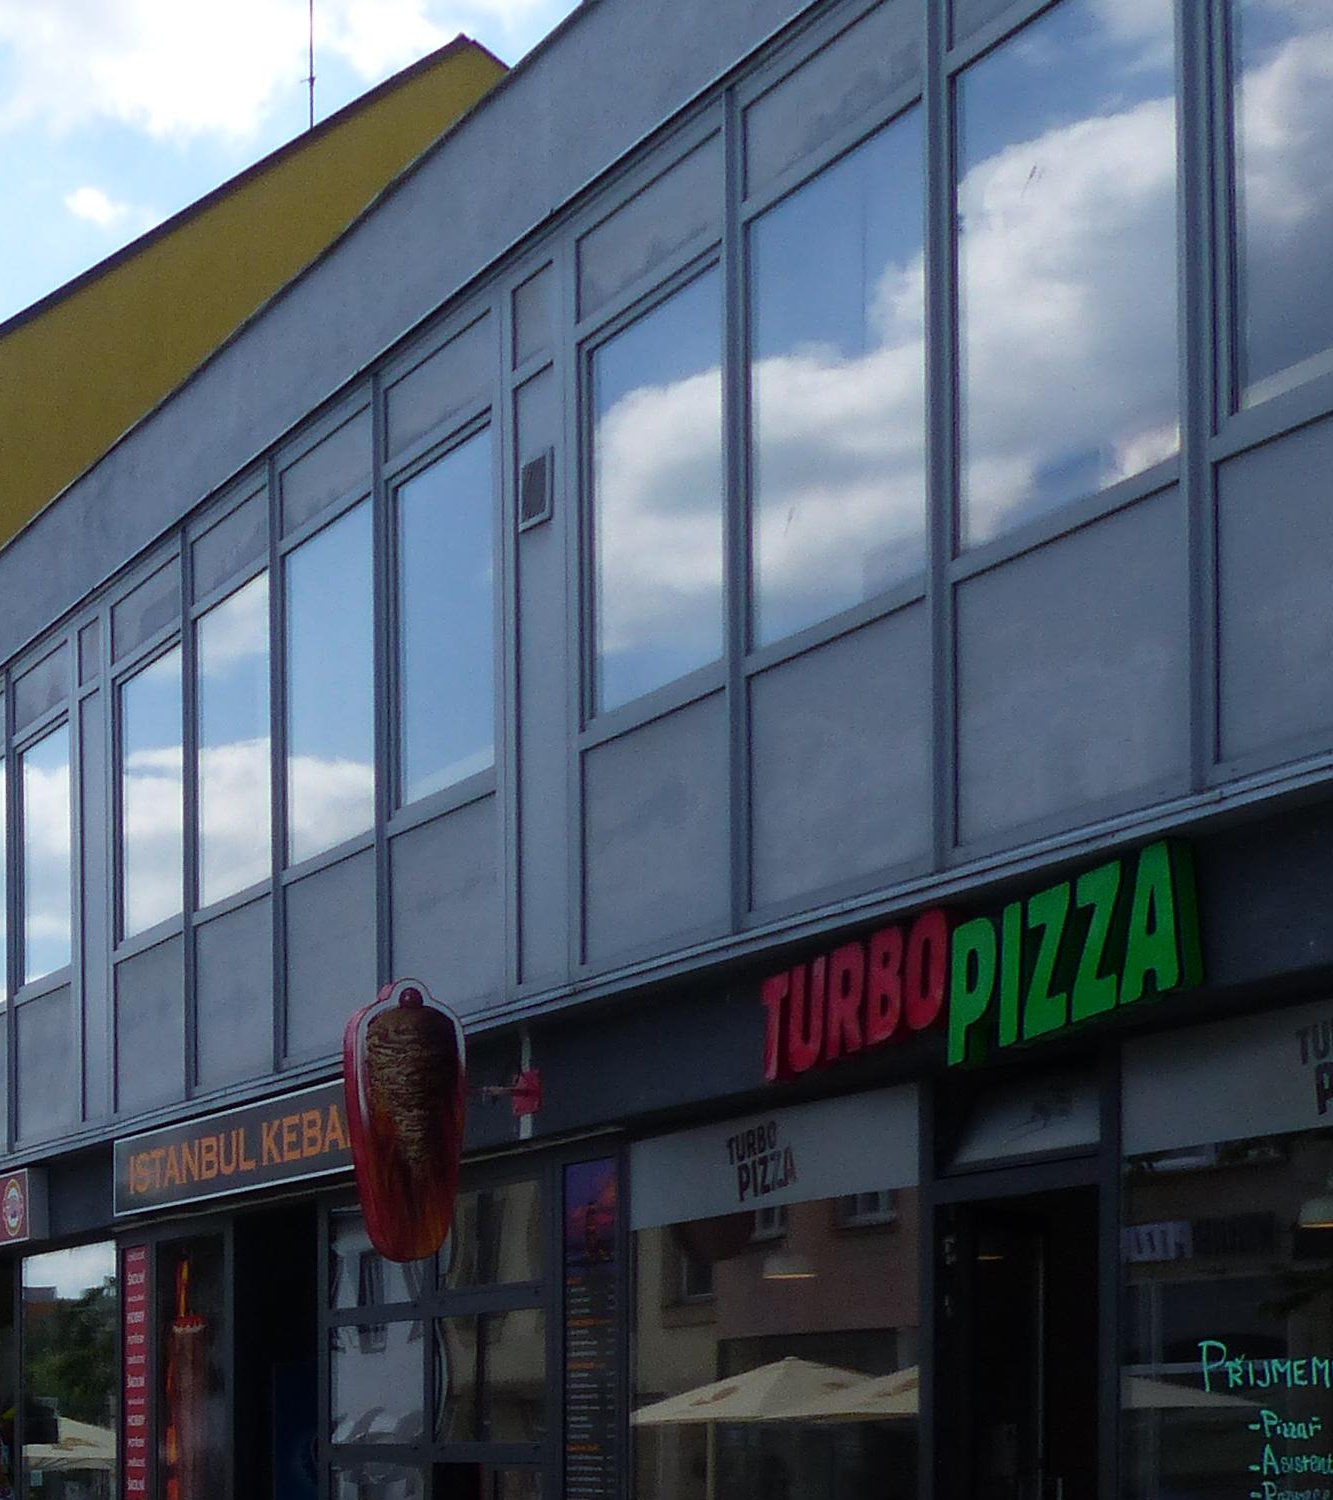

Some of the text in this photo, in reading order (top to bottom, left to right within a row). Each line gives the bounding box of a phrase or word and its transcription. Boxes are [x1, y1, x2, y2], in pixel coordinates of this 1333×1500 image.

[760, 840, 1199, 1082] TURBO PIZZA
[1295, 1022, 1333, 1065] TU
[1316, 1062, 1333, 1116] P
[129, 1103, 352, 1196] ISTANBUL KEBA
[727, 1120, 778, 1166] TURBO
[737, 1146, 798, 1202] PIZZA
[1197, 1340, 1333, 1393] PŘIJMEM
